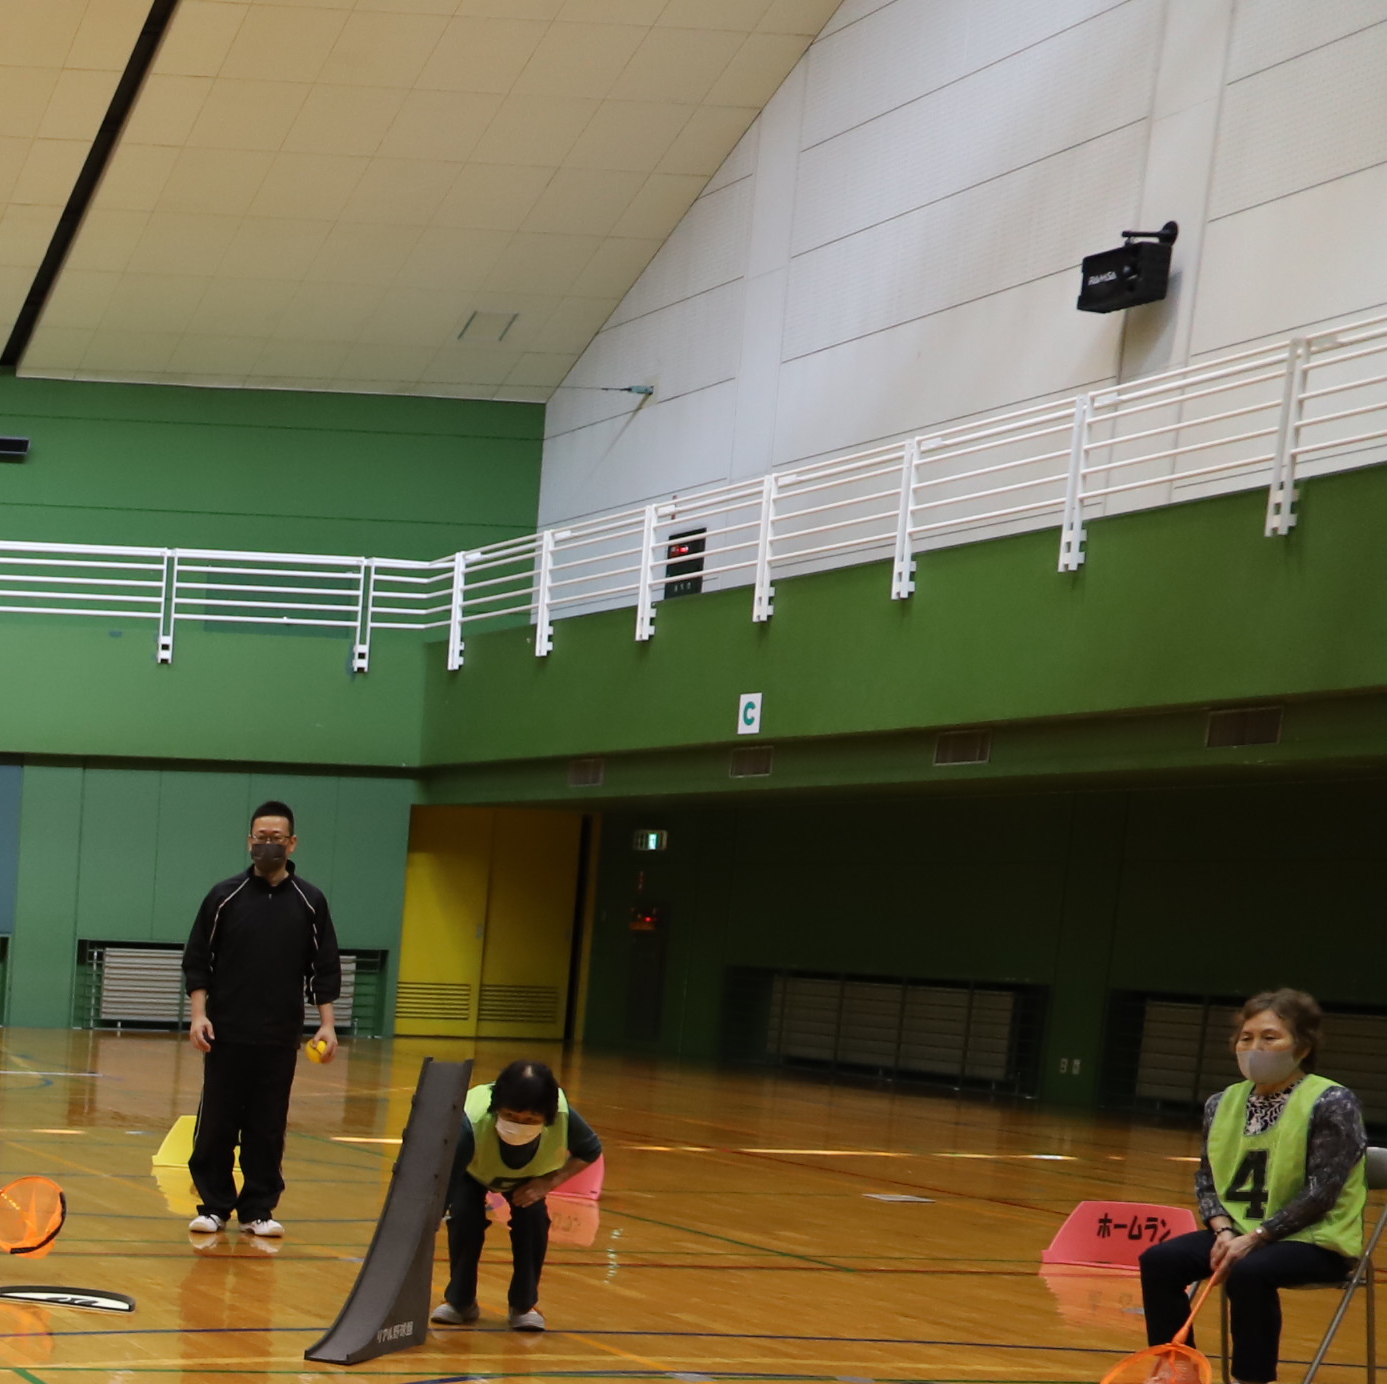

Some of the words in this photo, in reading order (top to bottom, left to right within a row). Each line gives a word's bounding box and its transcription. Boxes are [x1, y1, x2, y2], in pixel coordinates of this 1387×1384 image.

[743, 701, 756, 726] C
[1226, 1150, 1269, 1218] 4
[1097, 1213, 1171, 1243] ホームラン
